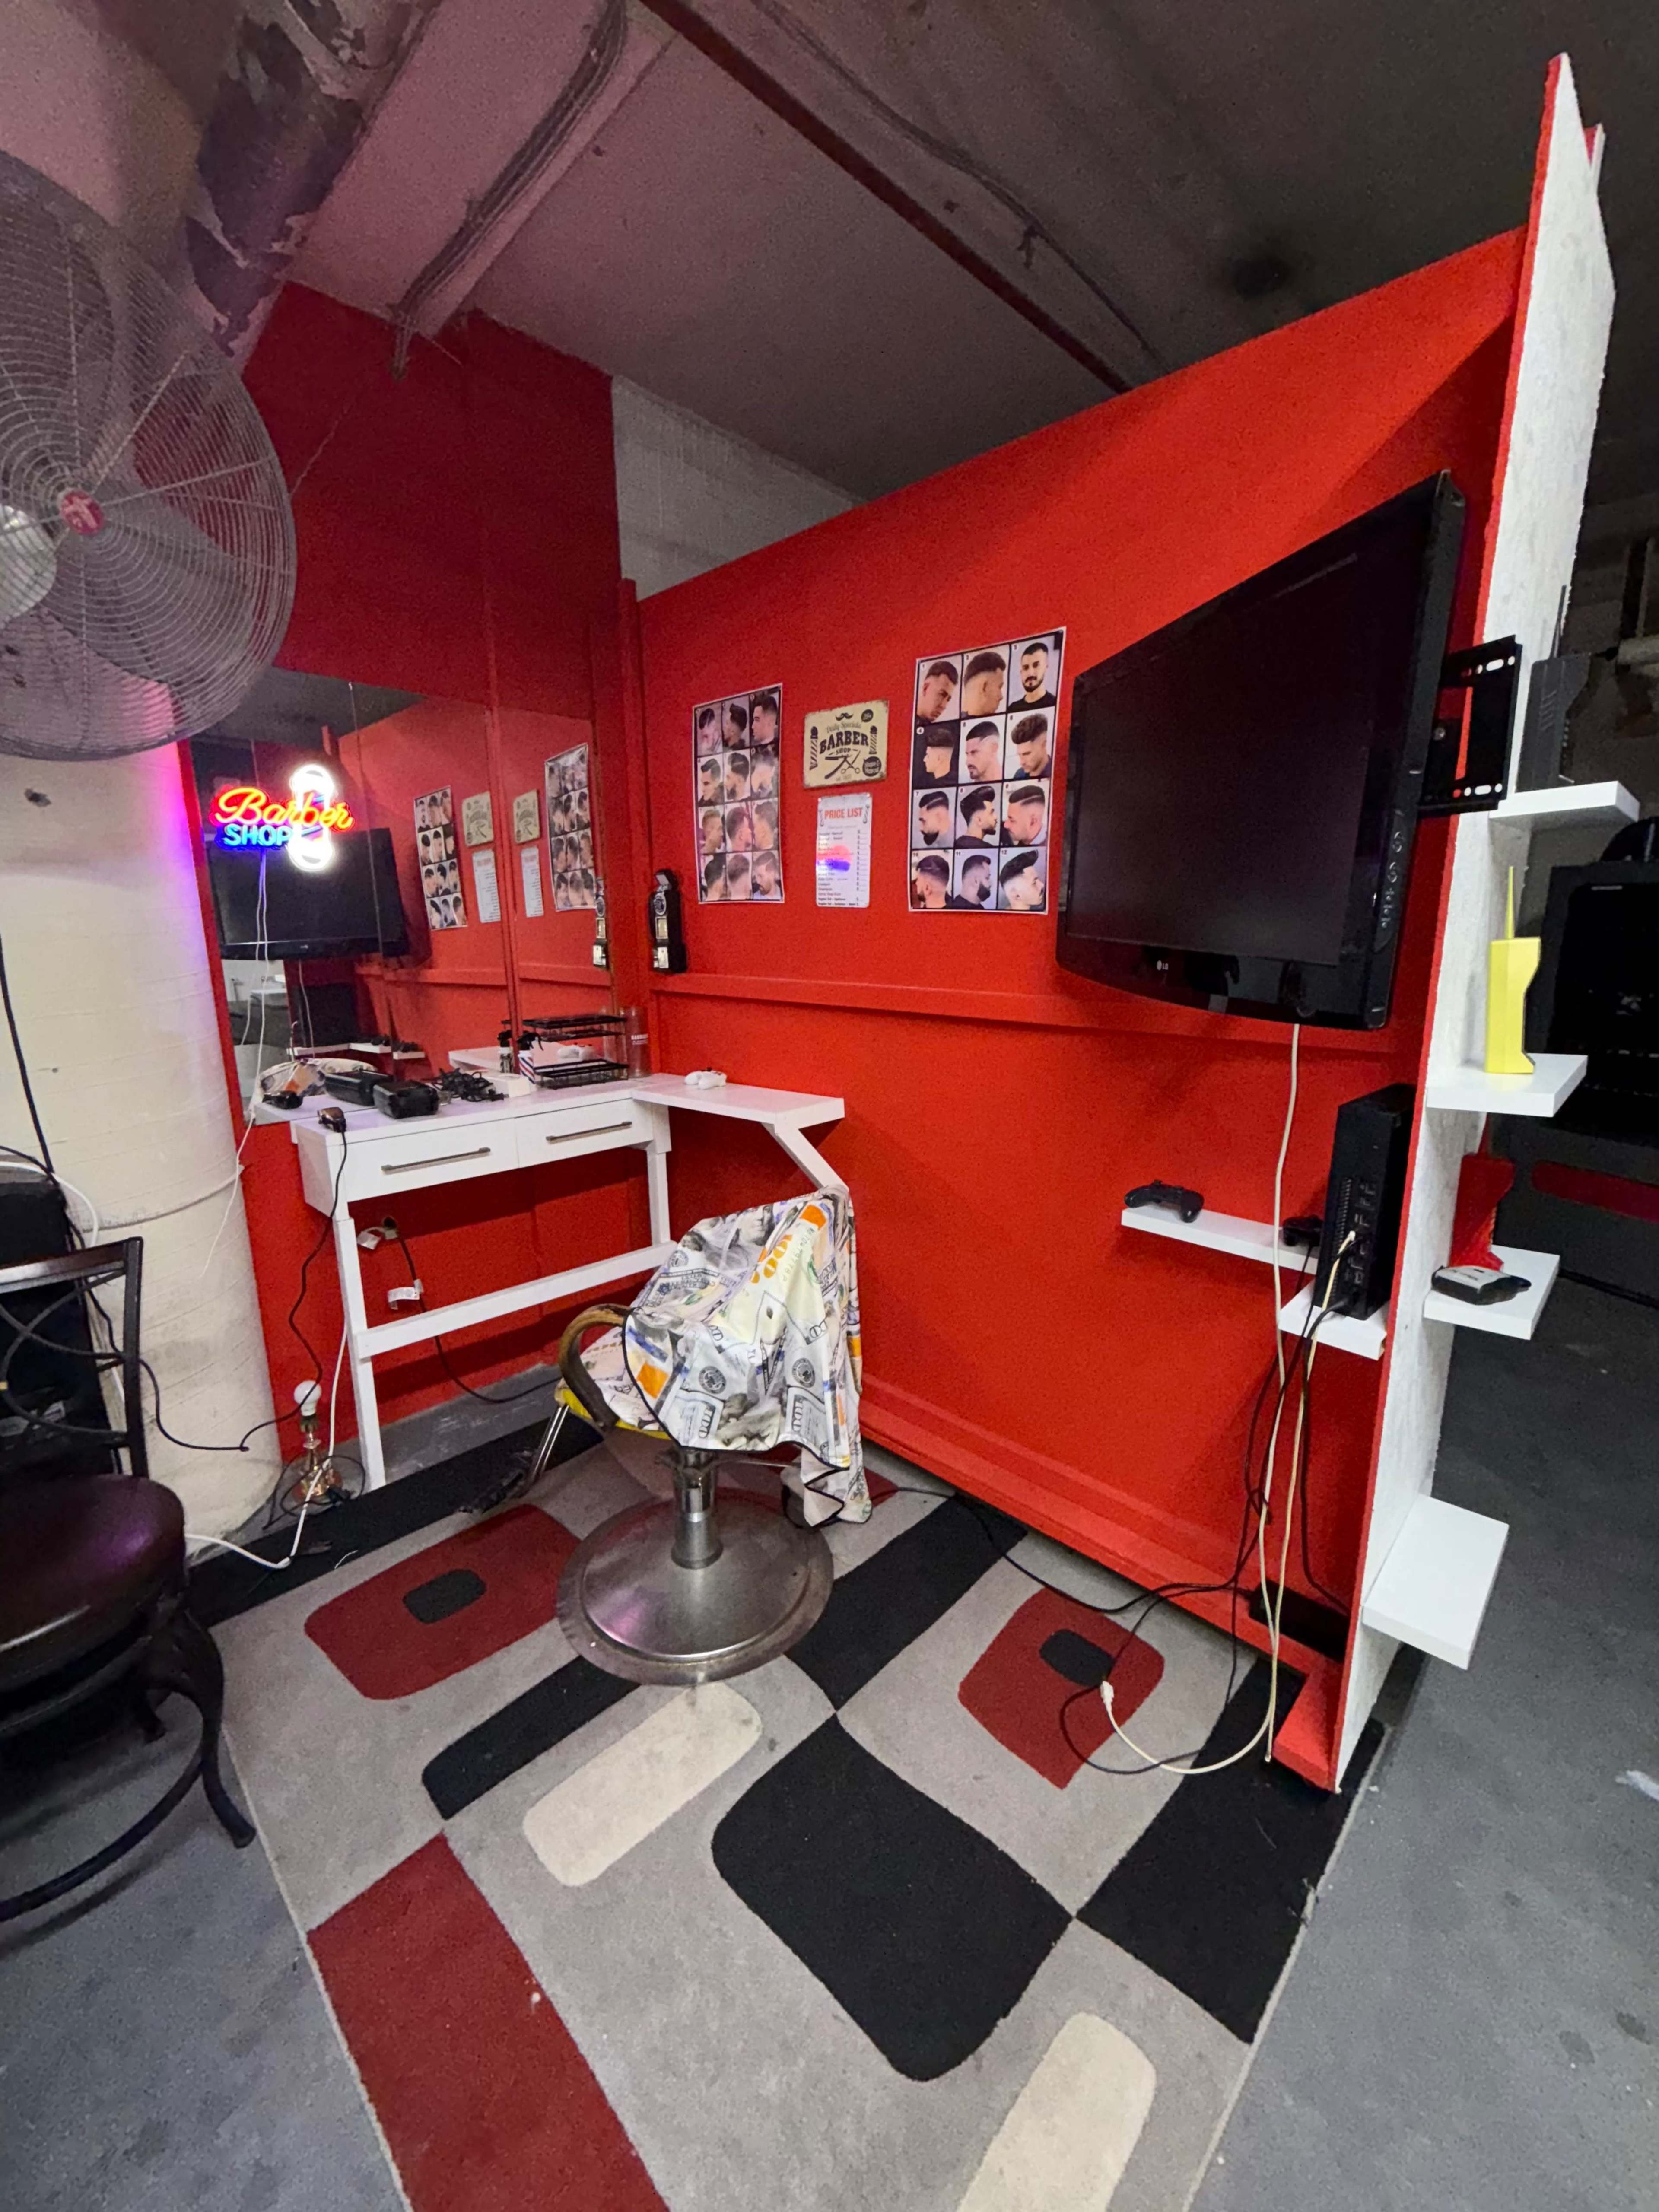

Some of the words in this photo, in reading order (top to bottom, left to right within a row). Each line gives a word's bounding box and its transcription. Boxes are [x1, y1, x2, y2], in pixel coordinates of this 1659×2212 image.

[819, 730, 869, 754] BARBER
[214, 787, 354, 830] Barber
[824, 809, 845, 819] PRICE
[847, 807, 863, 818] LIST
[223, 823, 292, 846] SHOP
